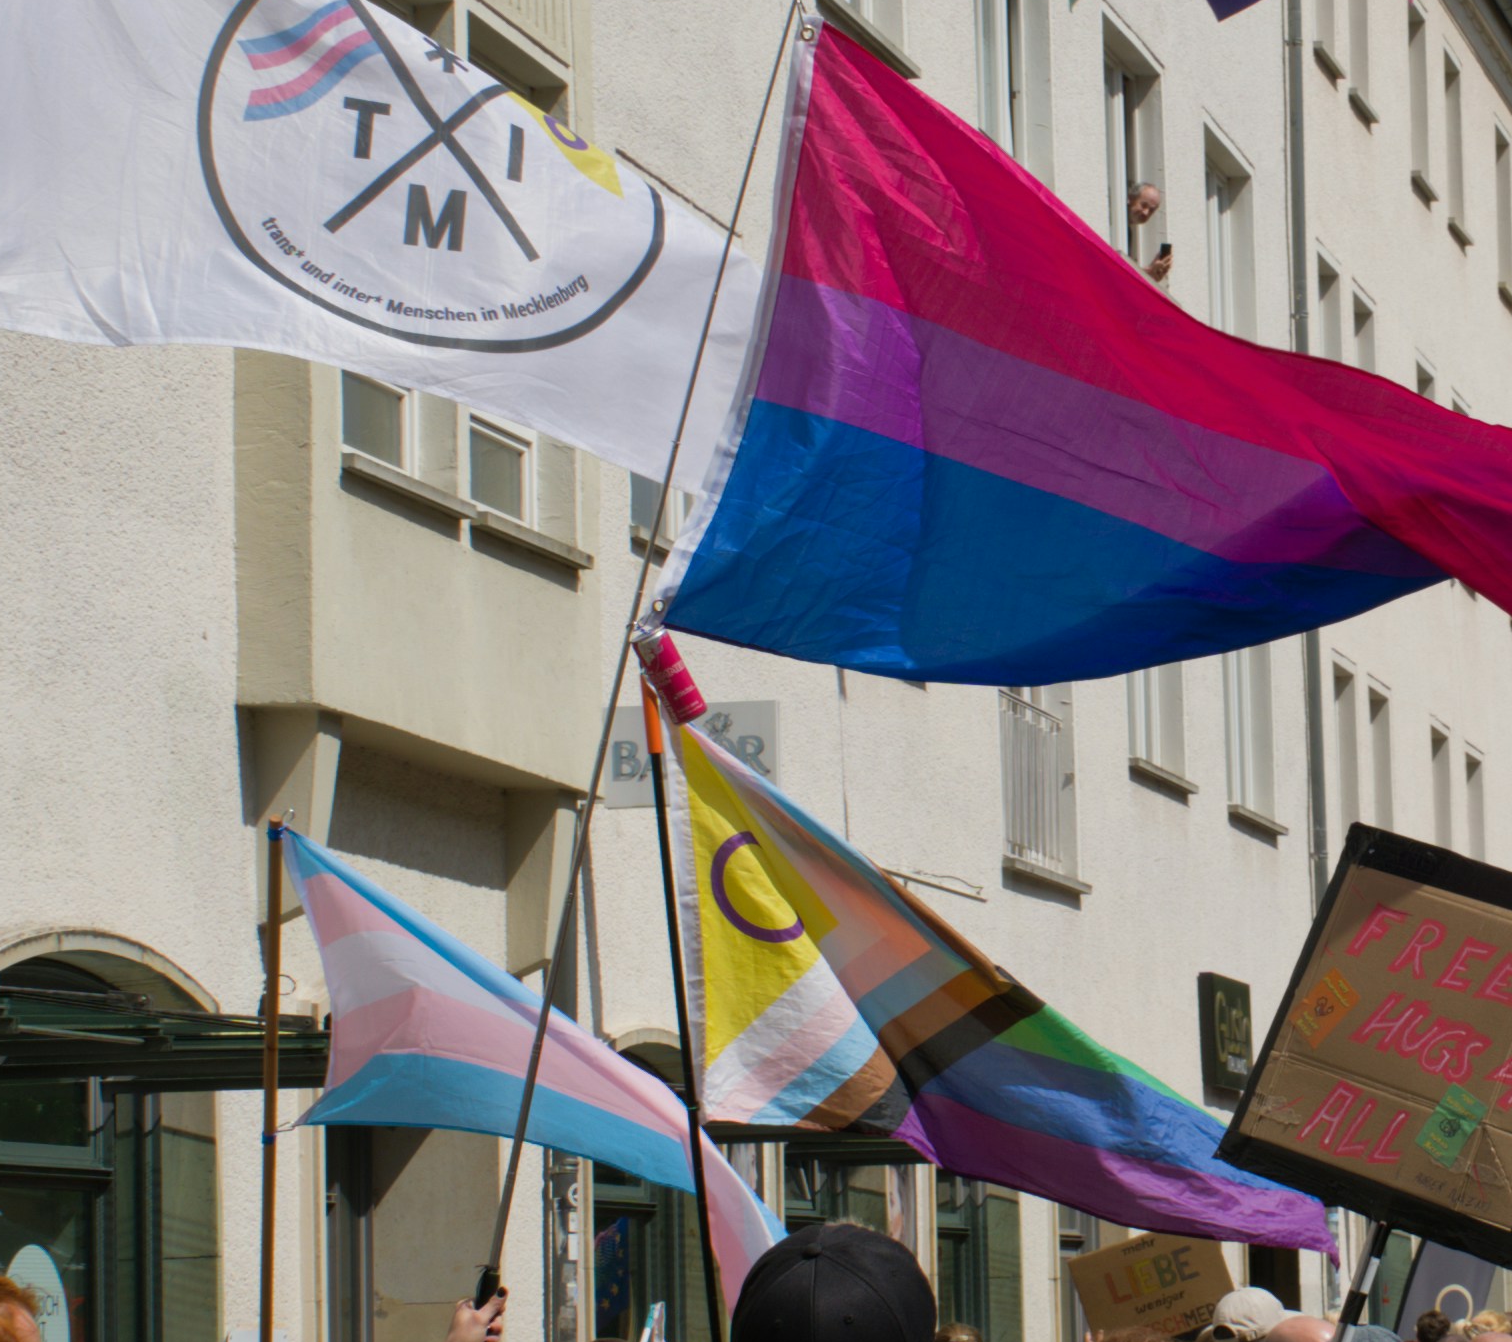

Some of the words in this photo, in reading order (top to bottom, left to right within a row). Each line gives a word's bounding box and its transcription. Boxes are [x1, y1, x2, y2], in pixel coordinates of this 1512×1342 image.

[343, 95, 392, 160] T
[403, 182, 468, 253] M
[299, 258, 332, 287] und
[385, 297, 477, 323] Menschen
[480, 306, 500, 323] in
[501, 272, 591, 320] Mecklenburg
[1348, 990, 1493, 1085] HUGS
[1296, 1078, 1410, 1165] ALL
[1104, 1245, 1201, 1305] LIEBE
[1122, 1236, 1156, 1256] mehr
[1134, 1289, 1186, 1314] weniger
